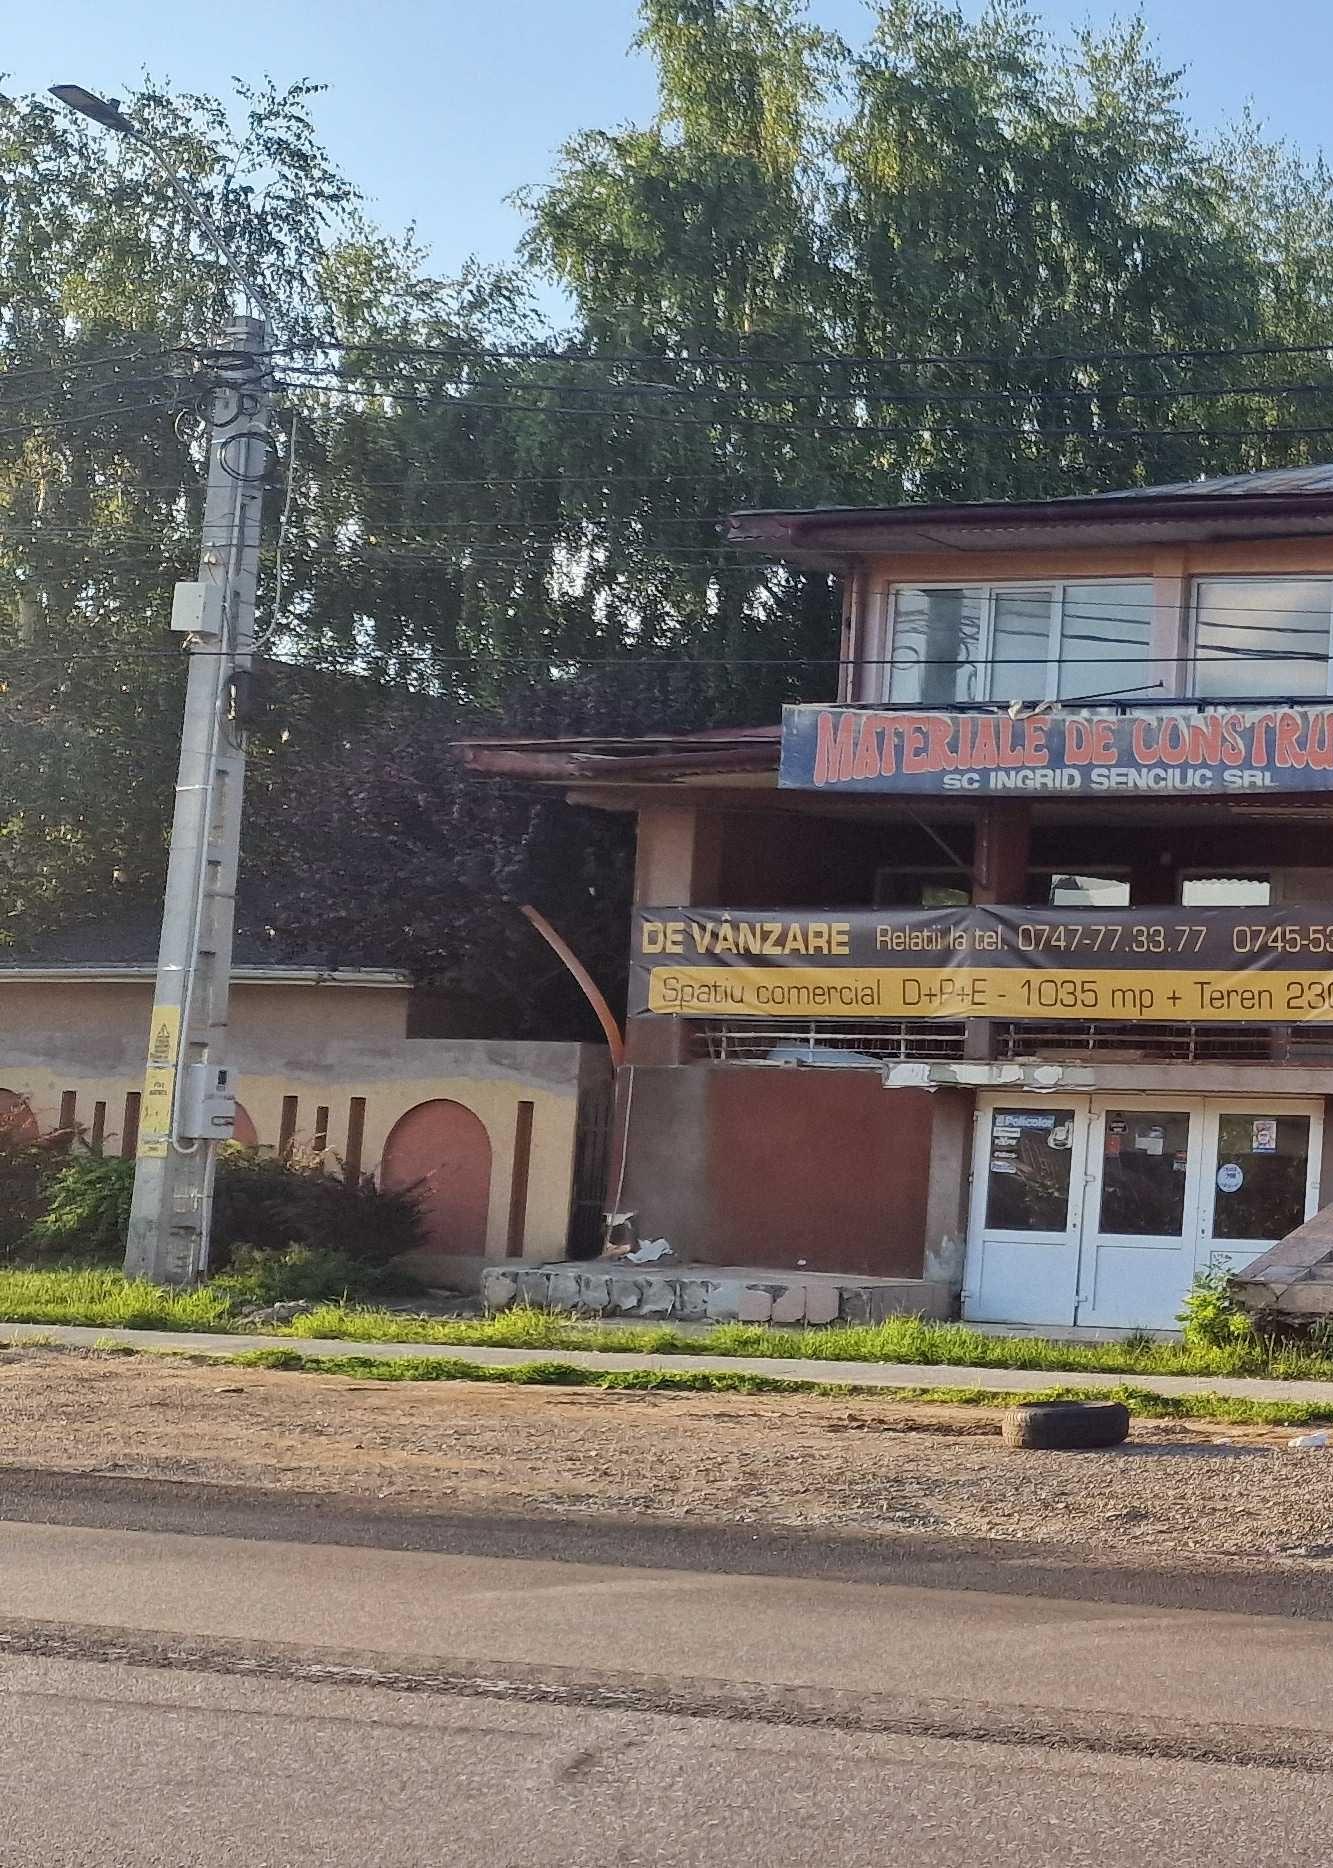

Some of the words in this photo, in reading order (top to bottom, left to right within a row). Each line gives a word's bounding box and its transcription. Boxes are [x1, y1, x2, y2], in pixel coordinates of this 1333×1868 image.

[813, 711, 1049, 787] MATERIALE
[1064, 713, 1117, 765] DE
[943, 771, 979, 791] SC
[989, 768, 1081, 791] INGRID
[1089, 768, 1212, 791] SENCIUC
[1222, 768, 1278, 789] SRL
[641, 922, 685, 955] DE
[694, 911, 850, 956] VÂNZARE
[876, 924, 942, 951] Relatii
[949, 924, 967, 951] la
[974, 923, 1008, 952] tel.
[1017, 924, 1207, 953] 0747-77.33.77
[662, 976, 745, 1010] Spatiu
[756, 977, 881, 1007] comercial
[901, 978, 988, 1007] D+P+E
[1020, 979, 1098, 1008] 1035
[1111, 985, 1154, 1016] mp
[1166, 990, 1182, 1007] +
[1193, 981, 1273, 1010] Teren
